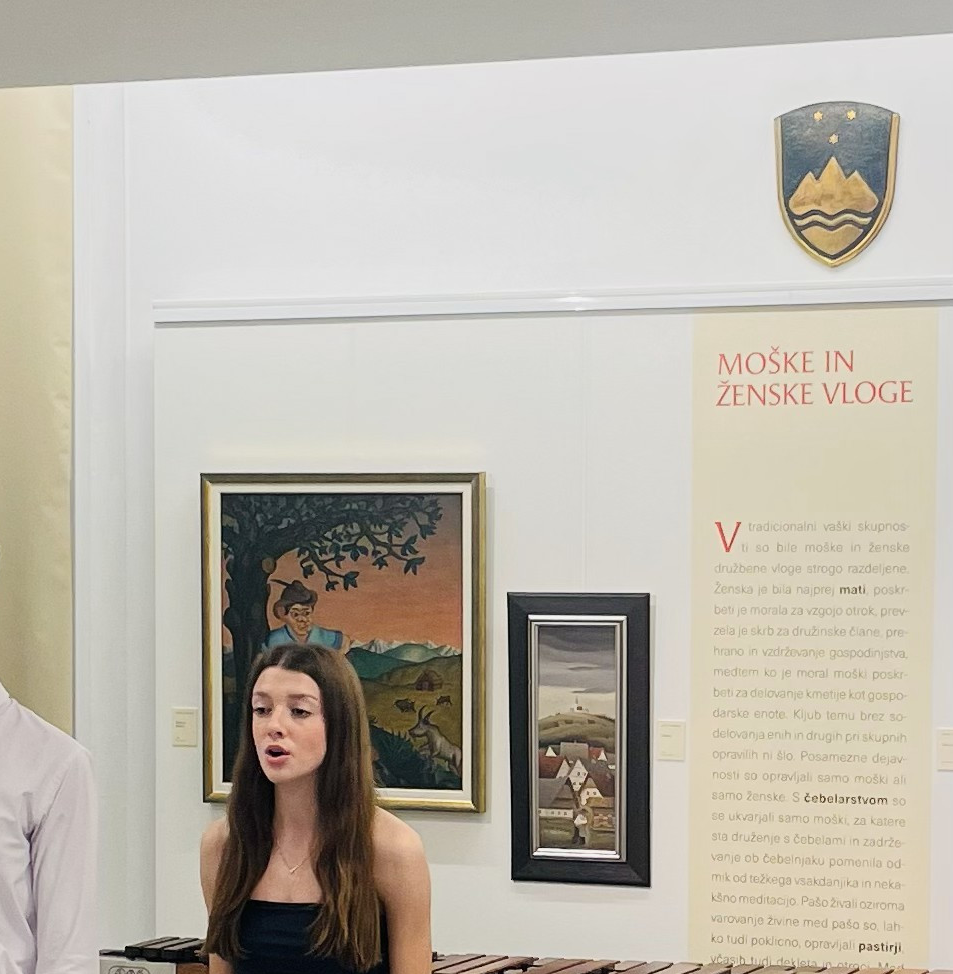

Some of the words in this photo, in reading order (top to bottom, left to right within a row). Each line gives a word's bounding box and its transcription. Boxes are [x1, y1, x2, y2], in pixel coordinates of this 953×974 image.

[718, 346, 814, 375] MOŠKE
[825, 350, 854, 373] IN
[716, 380, 814, 406] ŽENSKE
[822, 380, 913, 405] VLOGE
[715, 522, 742, 552] V
[804, 793, 888, 805] čebelarstvom
